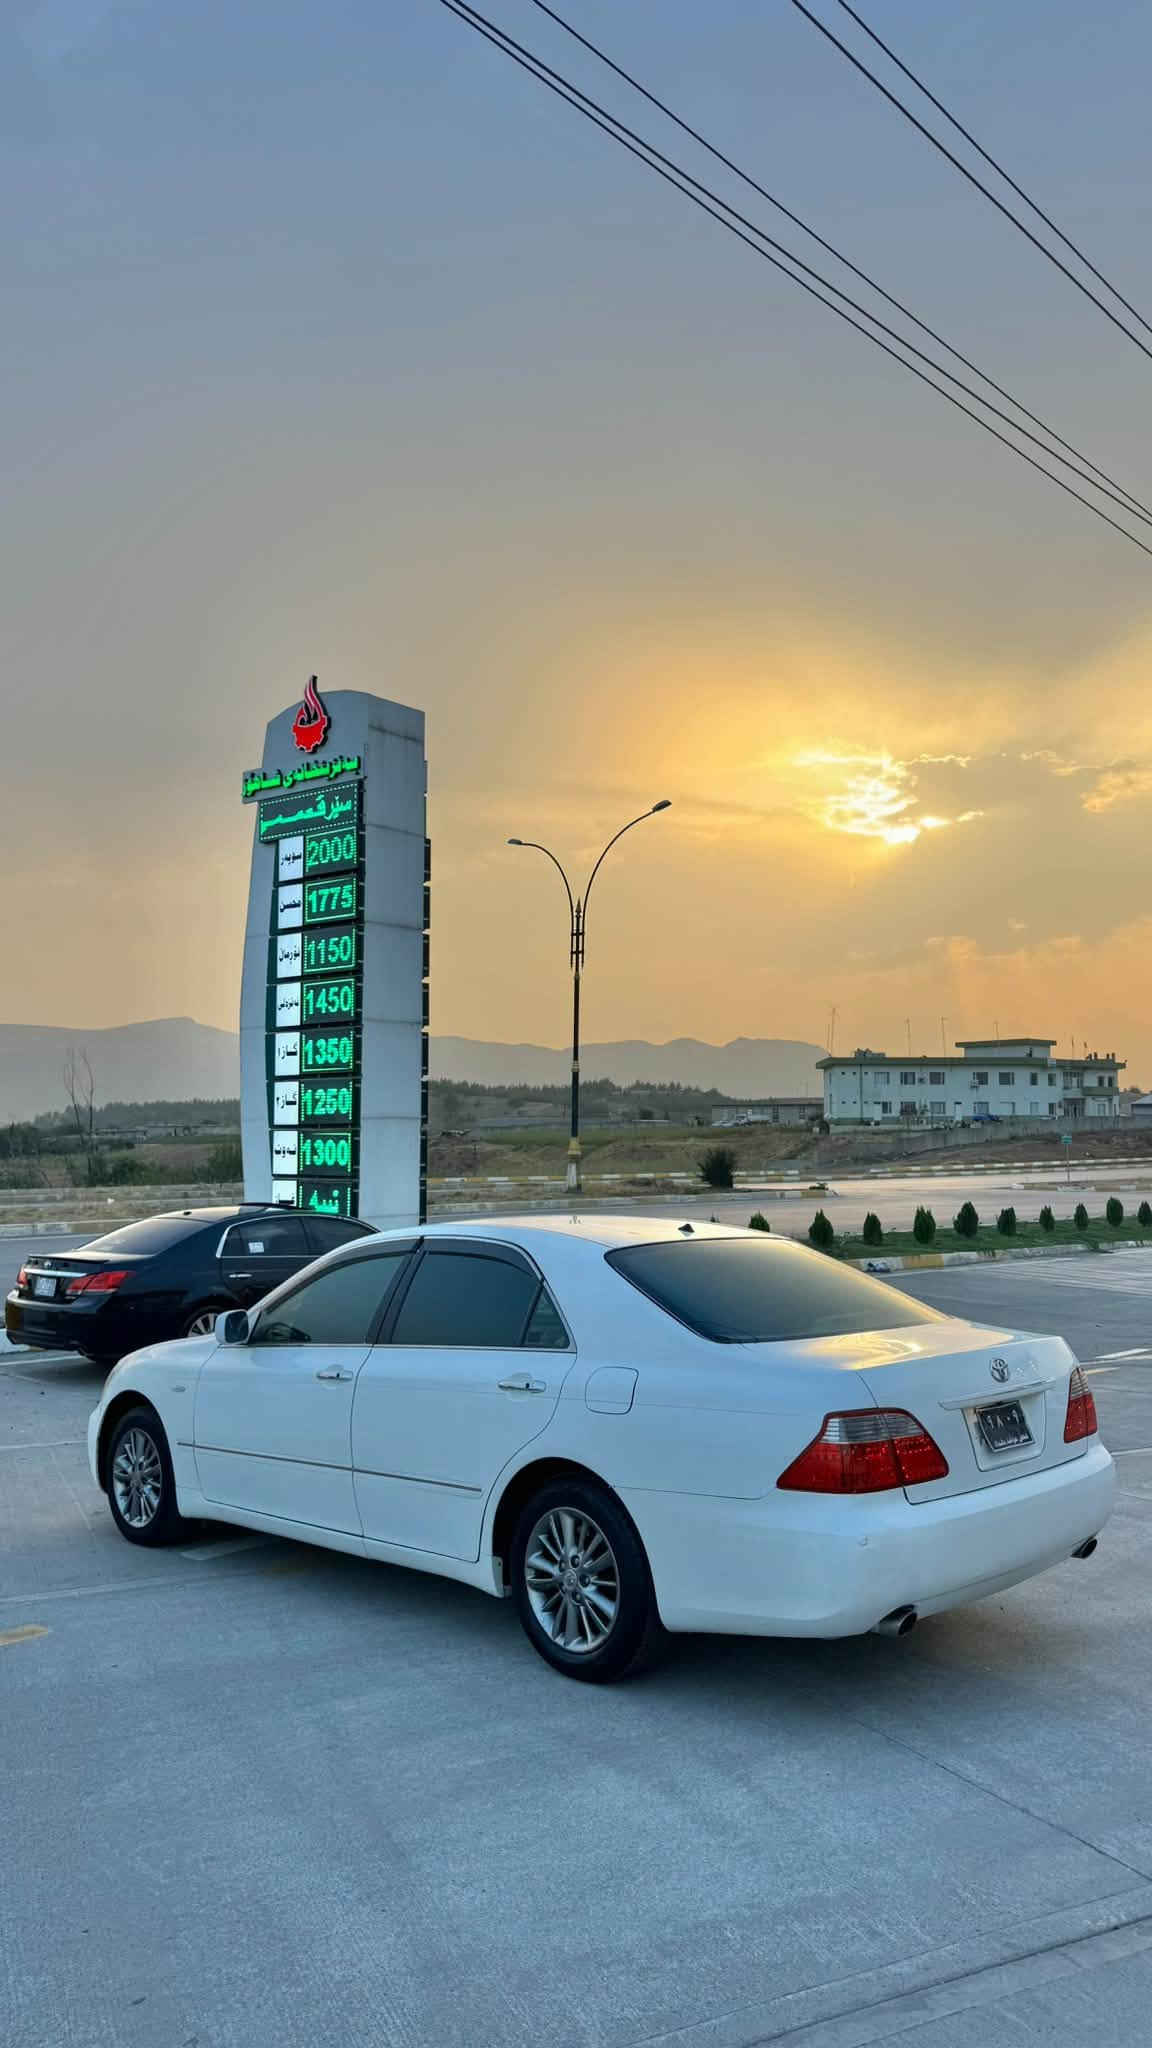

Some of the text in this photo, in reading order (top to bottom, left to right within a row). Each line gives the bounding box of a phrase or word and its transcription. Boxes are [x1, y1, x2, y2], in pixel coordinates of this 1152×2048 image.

[307, 833, 354, 866] 2000
[308, 884, 354, 913] 1775
[307, 935, 352, 965] 1150
[306, 985, 351, 1015] 1450
[304, 1037, 350, 1065] 1350
[303, 1087, 350, 1115] 1250
[302, 1138, 349, 1166] 1300
